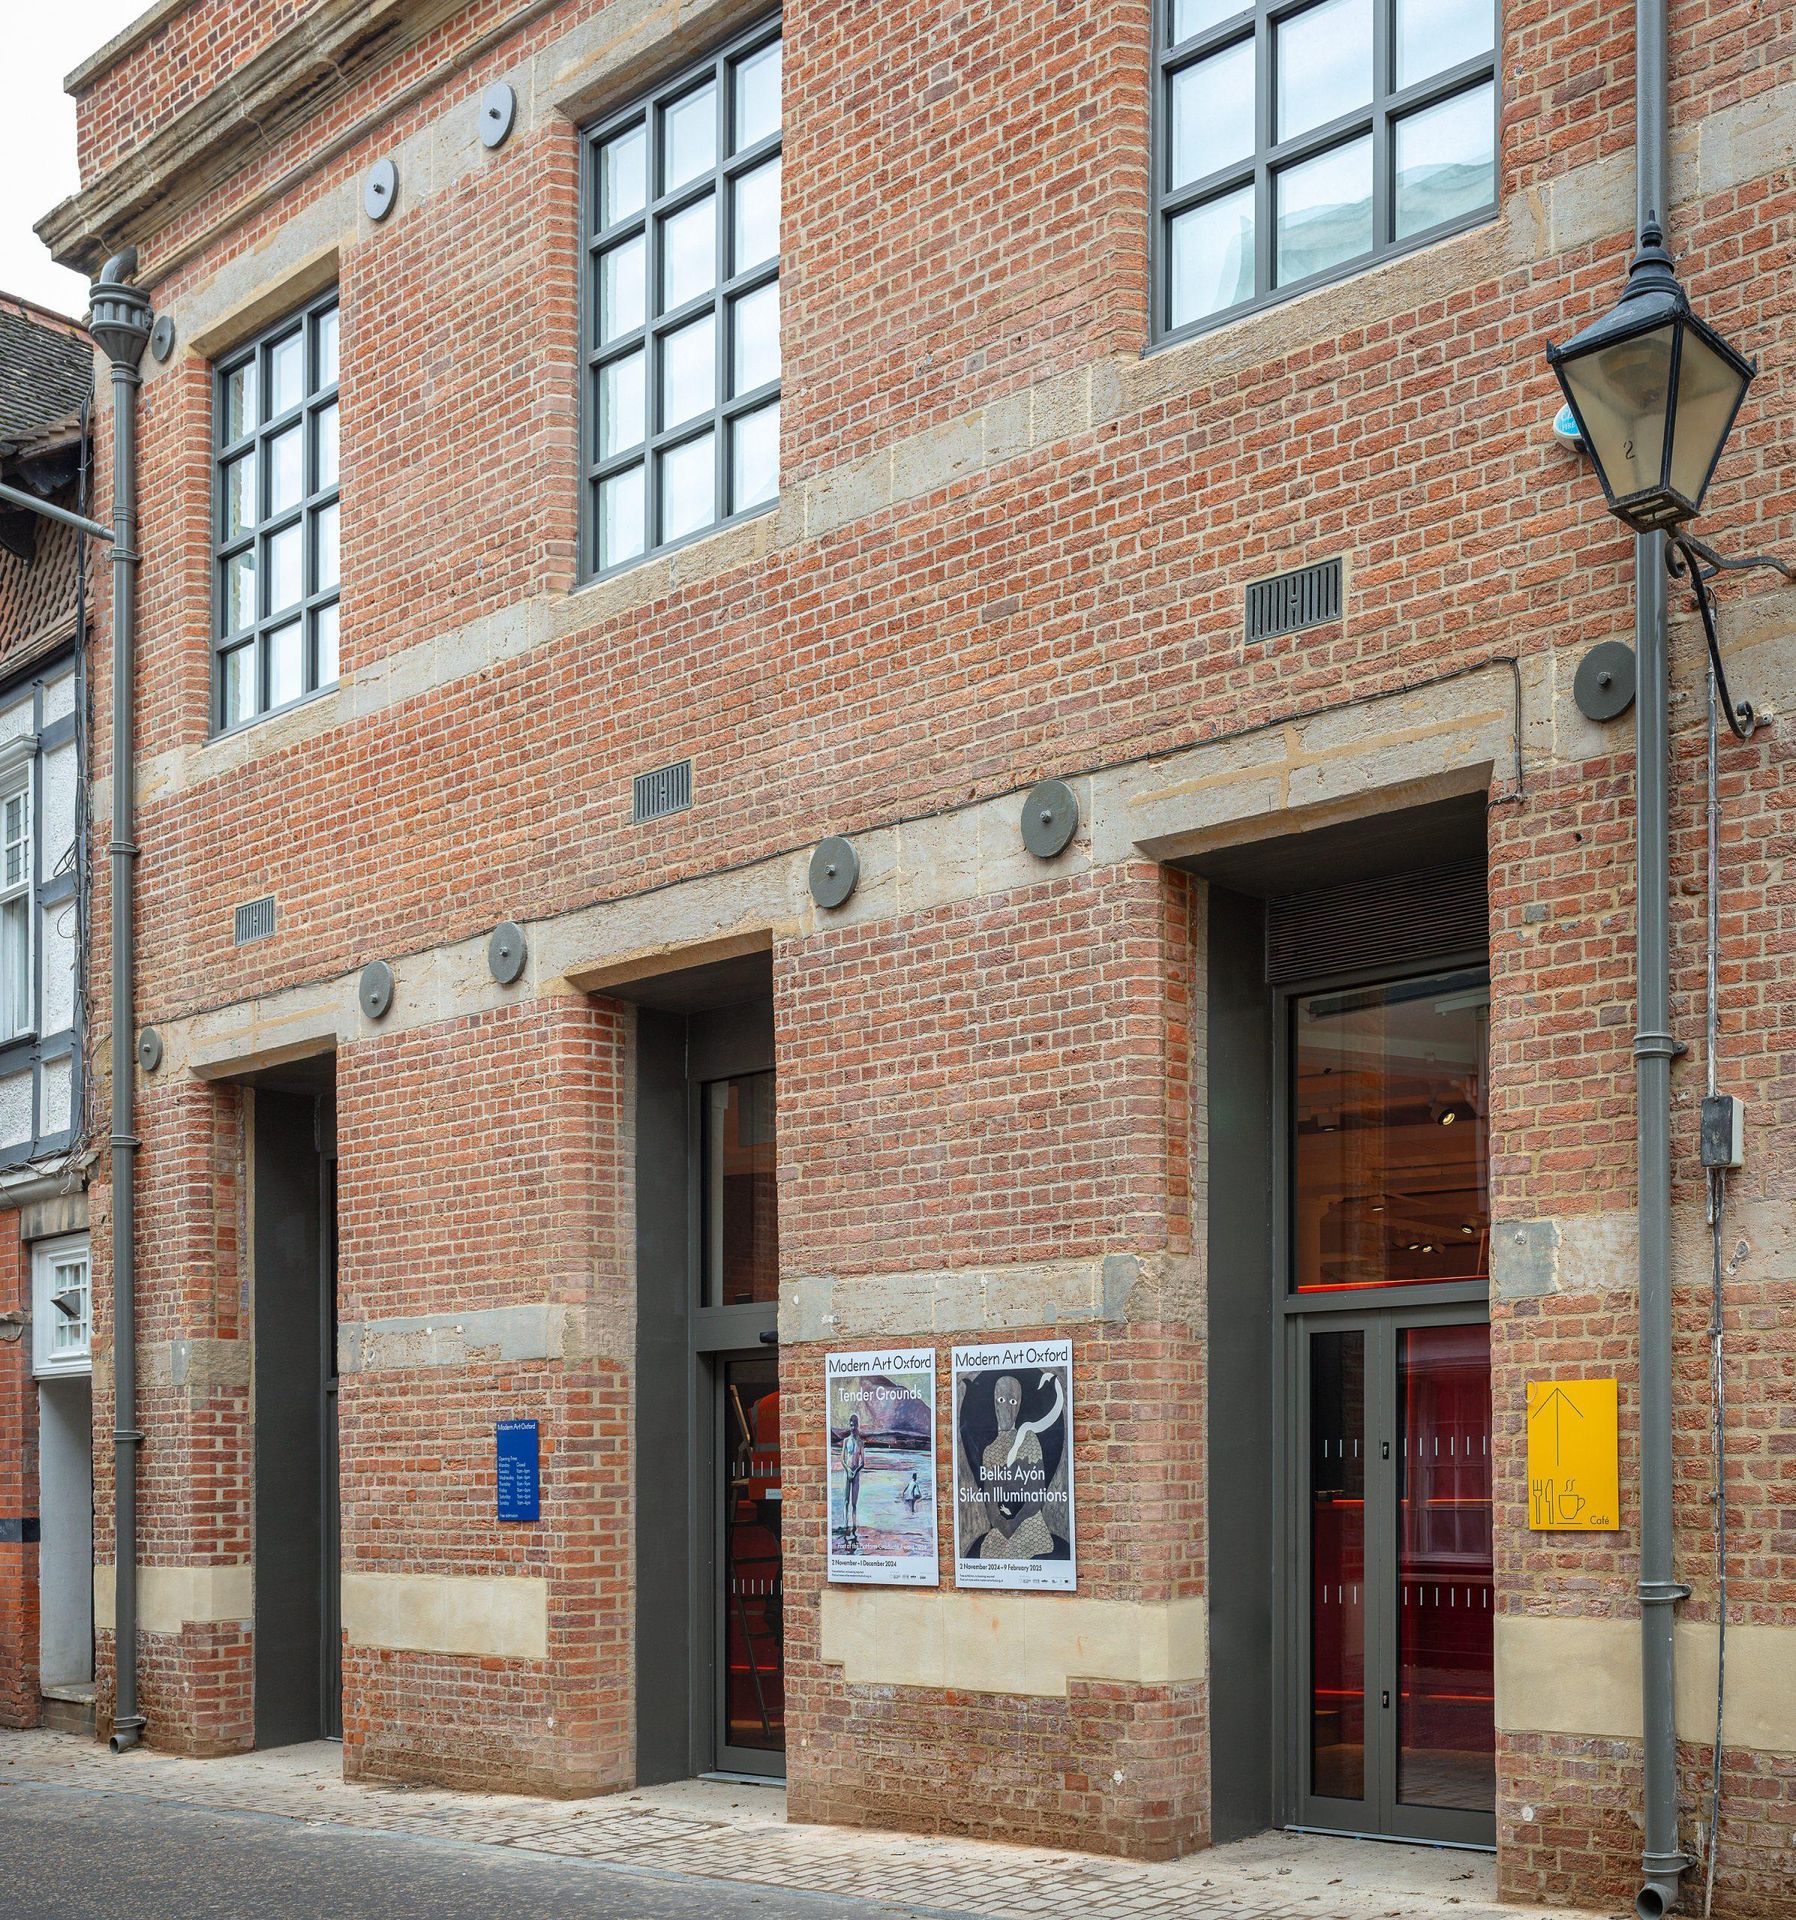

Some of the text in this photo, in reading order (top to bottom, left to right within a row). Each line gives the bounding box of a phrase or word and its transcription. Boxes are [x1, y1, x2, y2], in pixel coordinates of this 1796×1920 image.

[1623, 440, 1636, 460] 2
[829, 1354, 932, 1373] Modern Art Oxford
[956, 1346, 1068, 1367] Modern Art Oxford
[839, 1384, 922, 1402] Tender Grounds
[521, 1422, 535, 1430] Oxford
[980, 1466, 1045, 1485] Belkis Ayón
[960, 1487, 1068, 1502] Sikán Illuminations
[1590, 1515, 1609, 1525] Café
[1008, 1563, 1029, 1572] February
